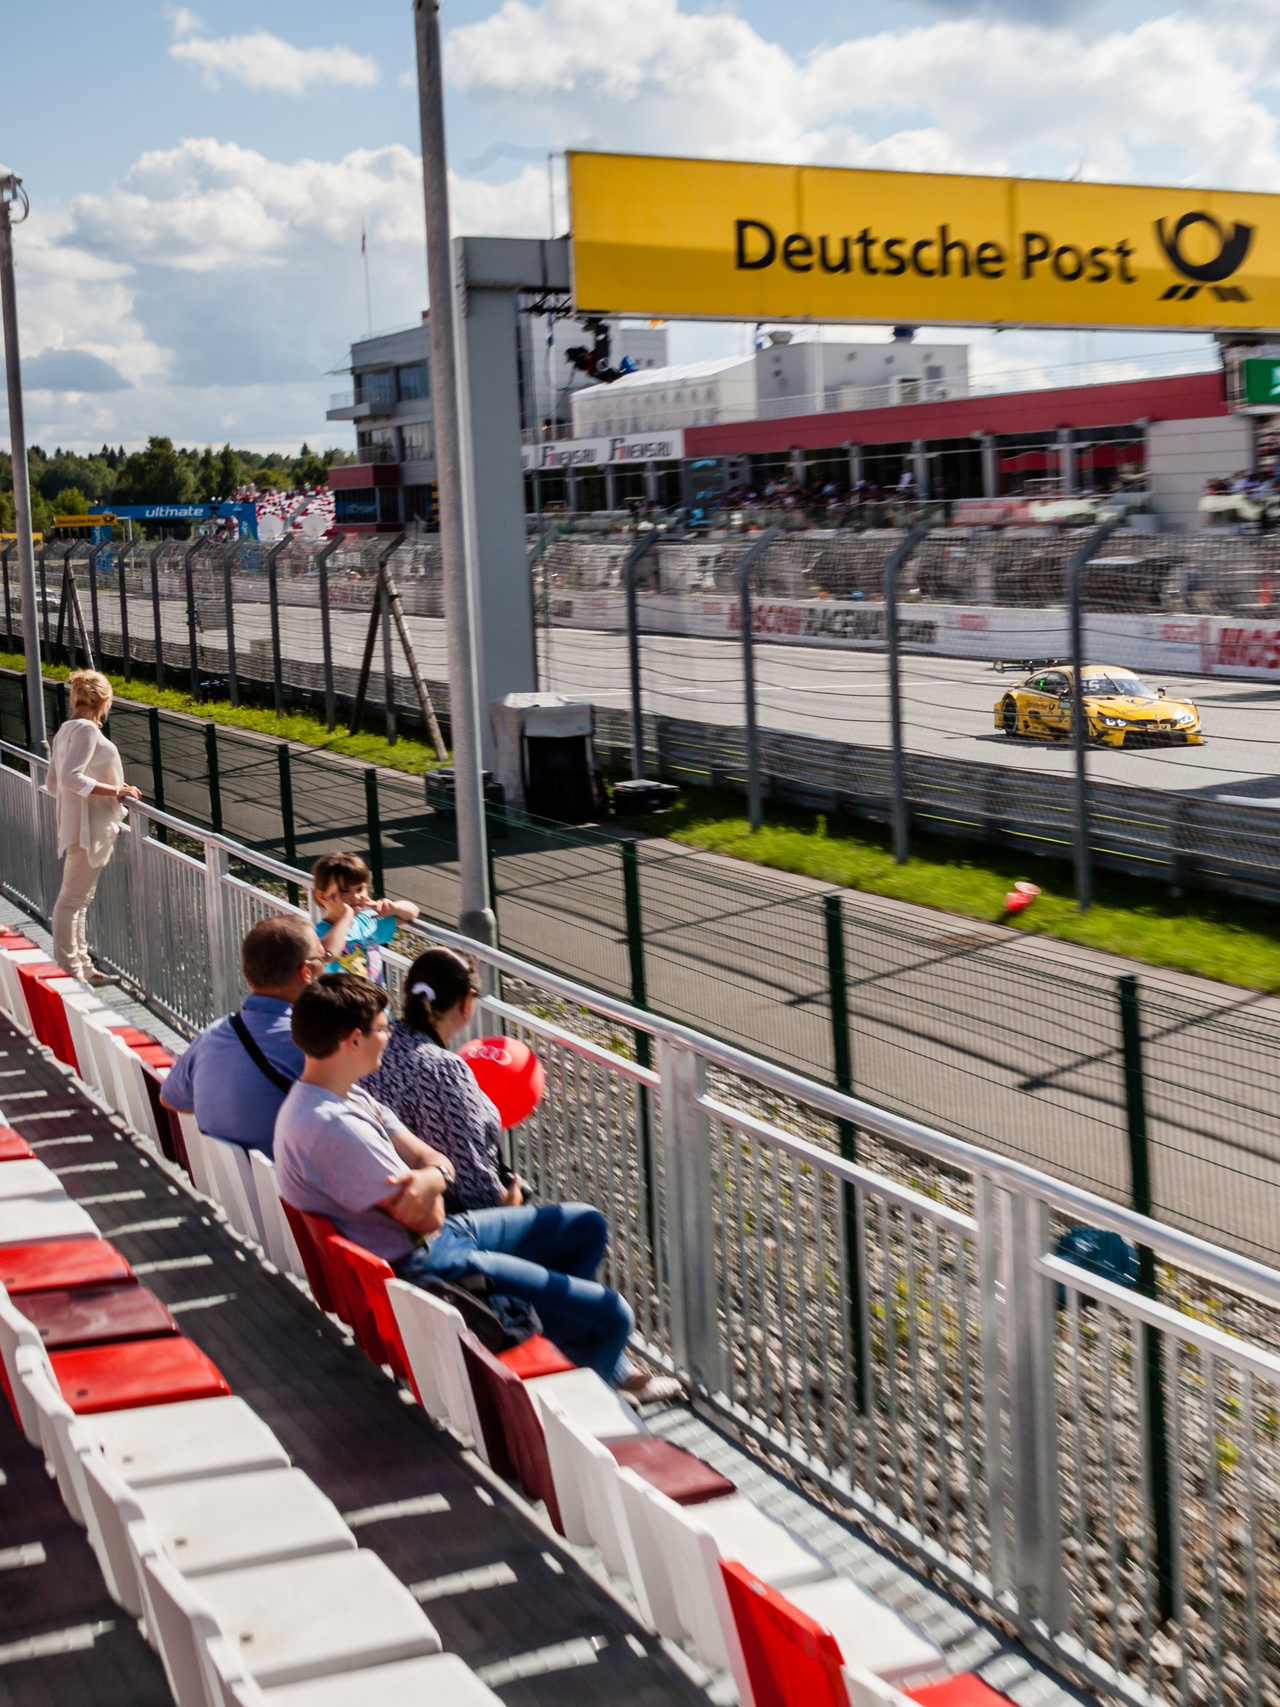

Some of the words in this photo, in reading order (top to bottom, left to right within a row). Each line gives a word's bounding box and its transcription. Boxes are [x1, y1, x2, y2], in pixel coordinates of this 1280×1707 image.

[733, 217, 1008, 281] Deutsche
[1020, 231, 1139, 285] Post
[145, 506, 204, 517] ultimate
